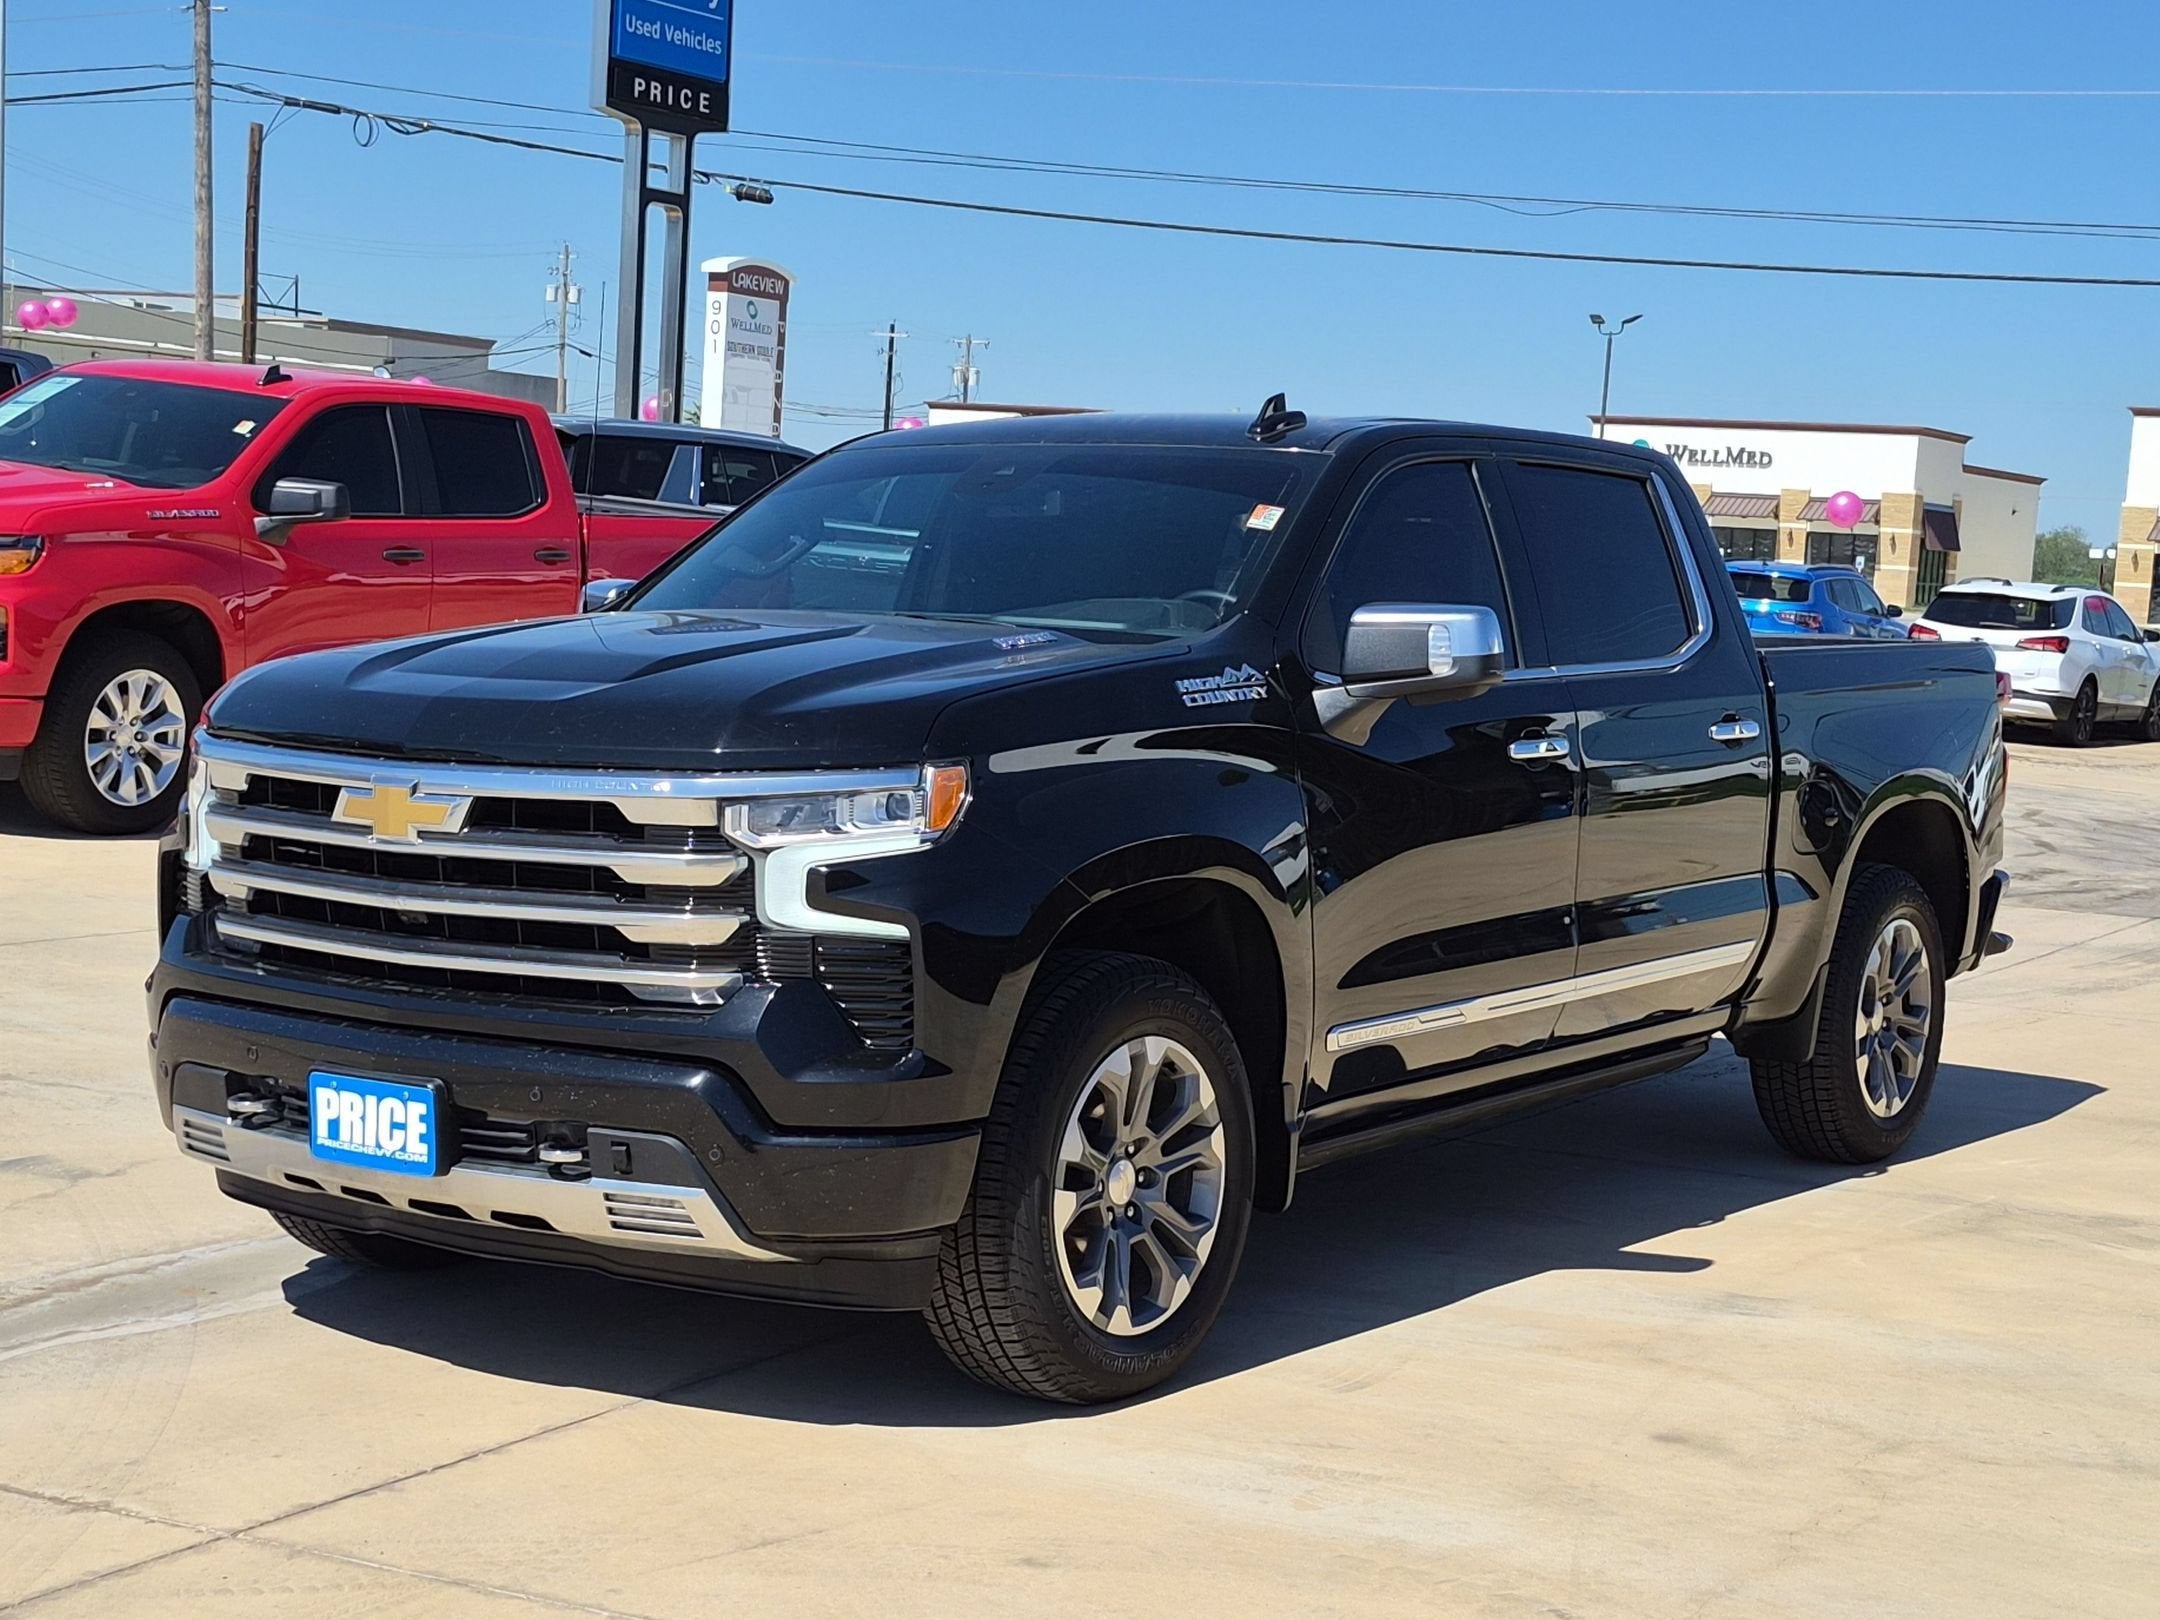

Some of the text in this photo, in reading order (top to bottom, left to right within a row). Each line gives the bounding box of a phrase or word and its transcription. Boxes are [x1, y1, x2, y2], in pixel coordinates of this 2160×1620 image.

[625, 13, 722, 55] Used Vehicles
[634, 77, 711, 113] PRICE
[732, 271, 785, 295] LAKEVIEW
[1182, 686, 1268, 707] COUNTRY
[1345, 1020, 1417, 1043] SILVERADO
[316, 1087, 429, 1155] PRICE
[316, 1136, 429, 1163] PRICECHEVY.COM
